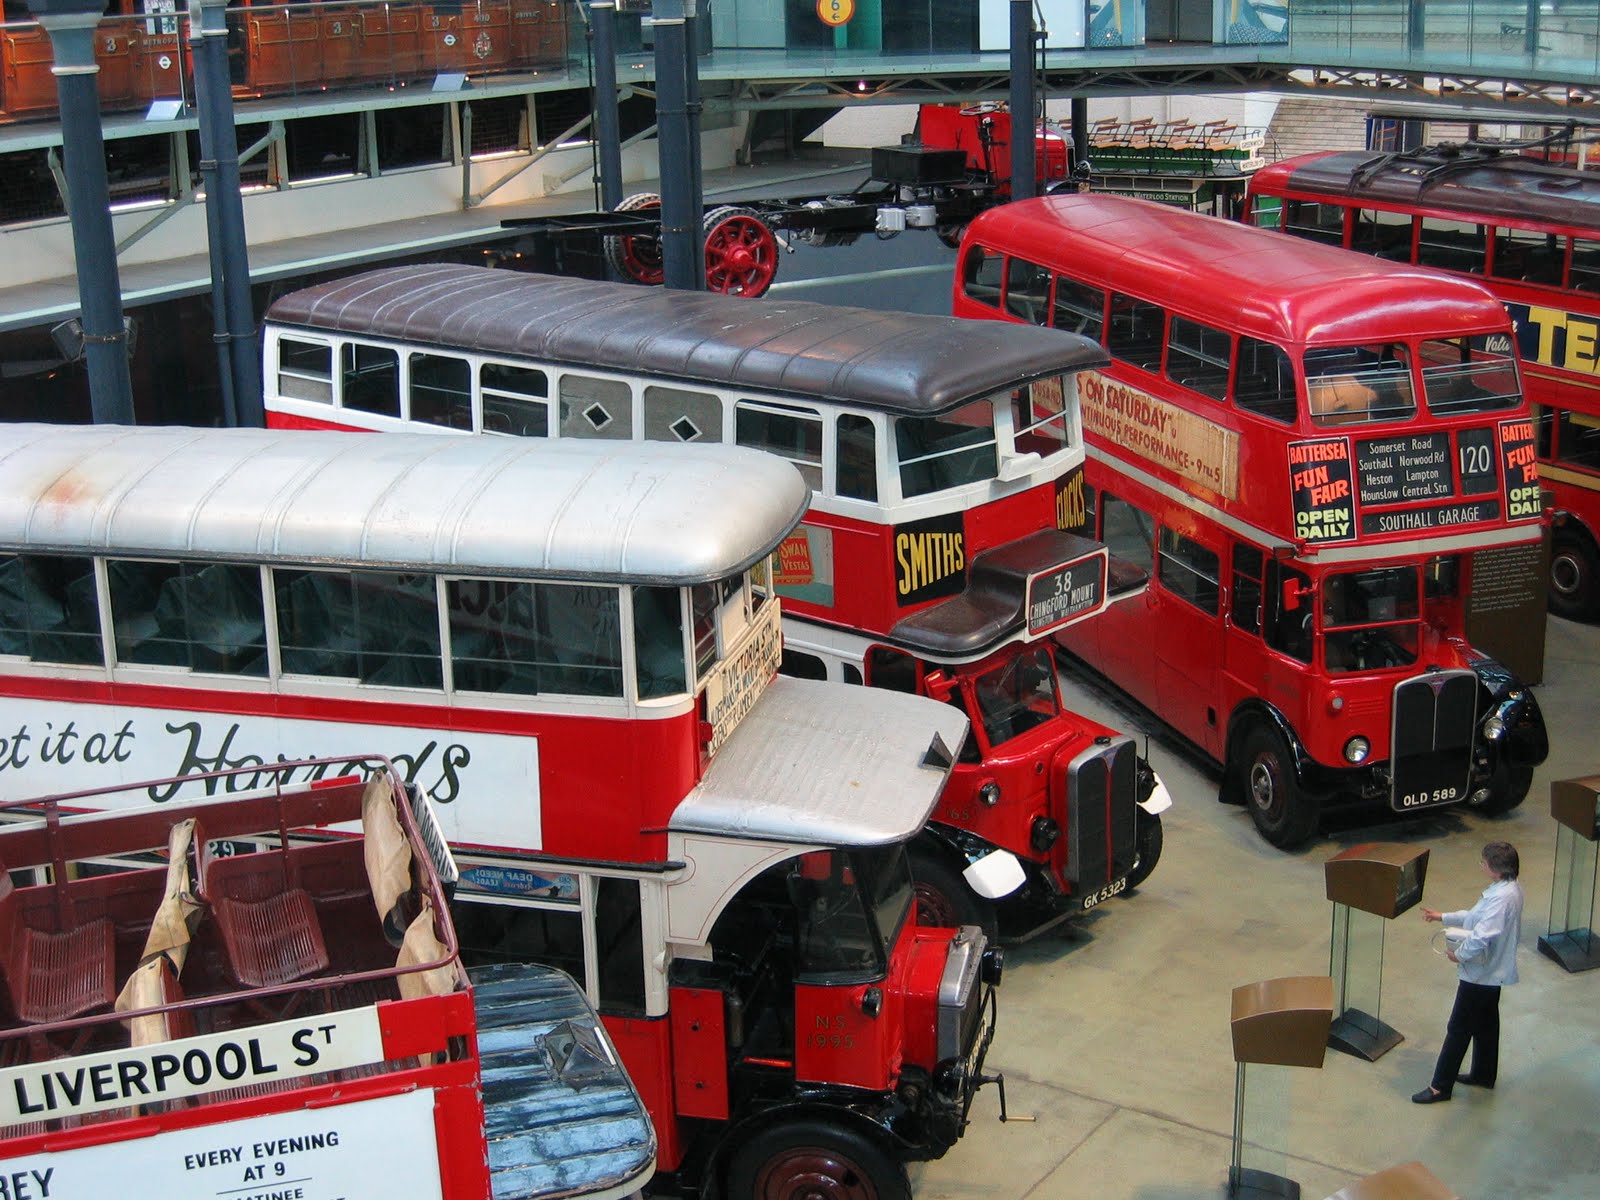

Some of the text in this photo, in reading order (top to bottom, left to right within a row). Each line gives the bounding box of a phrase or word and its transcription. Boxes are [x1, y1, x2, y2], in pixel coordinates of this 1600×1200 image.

[831, 0, 840, 11] 6
[1165, 192, 1189, 201] STATION
[1529, 306, 1600, 376] TE
[1124, 424, 1189, 469] PERFORMANCE
[1214, 467, 1221, 483] 5
[1290, 443, 1347, 464] BATTERSEA
[1369, 437, 1432, 454] Somerset Road
[1506, 444, 1535, 469] FUN
[1359, 451, 1445, 471] Southall Norwood Rd
[1460, 445, 1490, 474] 120
[1294, 465, 1329, 492] FUN
[1366, 470, 1439, 486] Heston Lampton
[1056, 470, 1086, 530] CLOCKS
[1310, 479, 1350, 507] FAIR
[1361, 482, 1448, 501] Hounslow Central Stn
[1296, 508, 1349, 525] OPEN
[1379, 506, 1480, 532] SOUTHALL GARAGE
[1297, 522, 1350, 539] DAILY
[780, 543, 808, 559] SWAN
[783, 559, 810, 571] VESTAS
[897, 533, 964, 595] SMITHS
[1054, 571, 1072, 596] 38
[1030, 583, 1095, 620] CHINGFORD MOUNT
[727, 639, 760, 688] VICTORIA
[41, 721, 78, 764] it
[83, 720, 135, 764] at
[1403, 787, 1456, 806] OLD 589
[1084, 877, 1126, 909] GK 5323
[808, 1035, 855, 1049] 1995
[14, 1025, 336, 1114] LIVERPOOL ST
[184, 1131, 339, 1170] EVERY EVENING
[243, 1162, 285, 1182] AT 9
